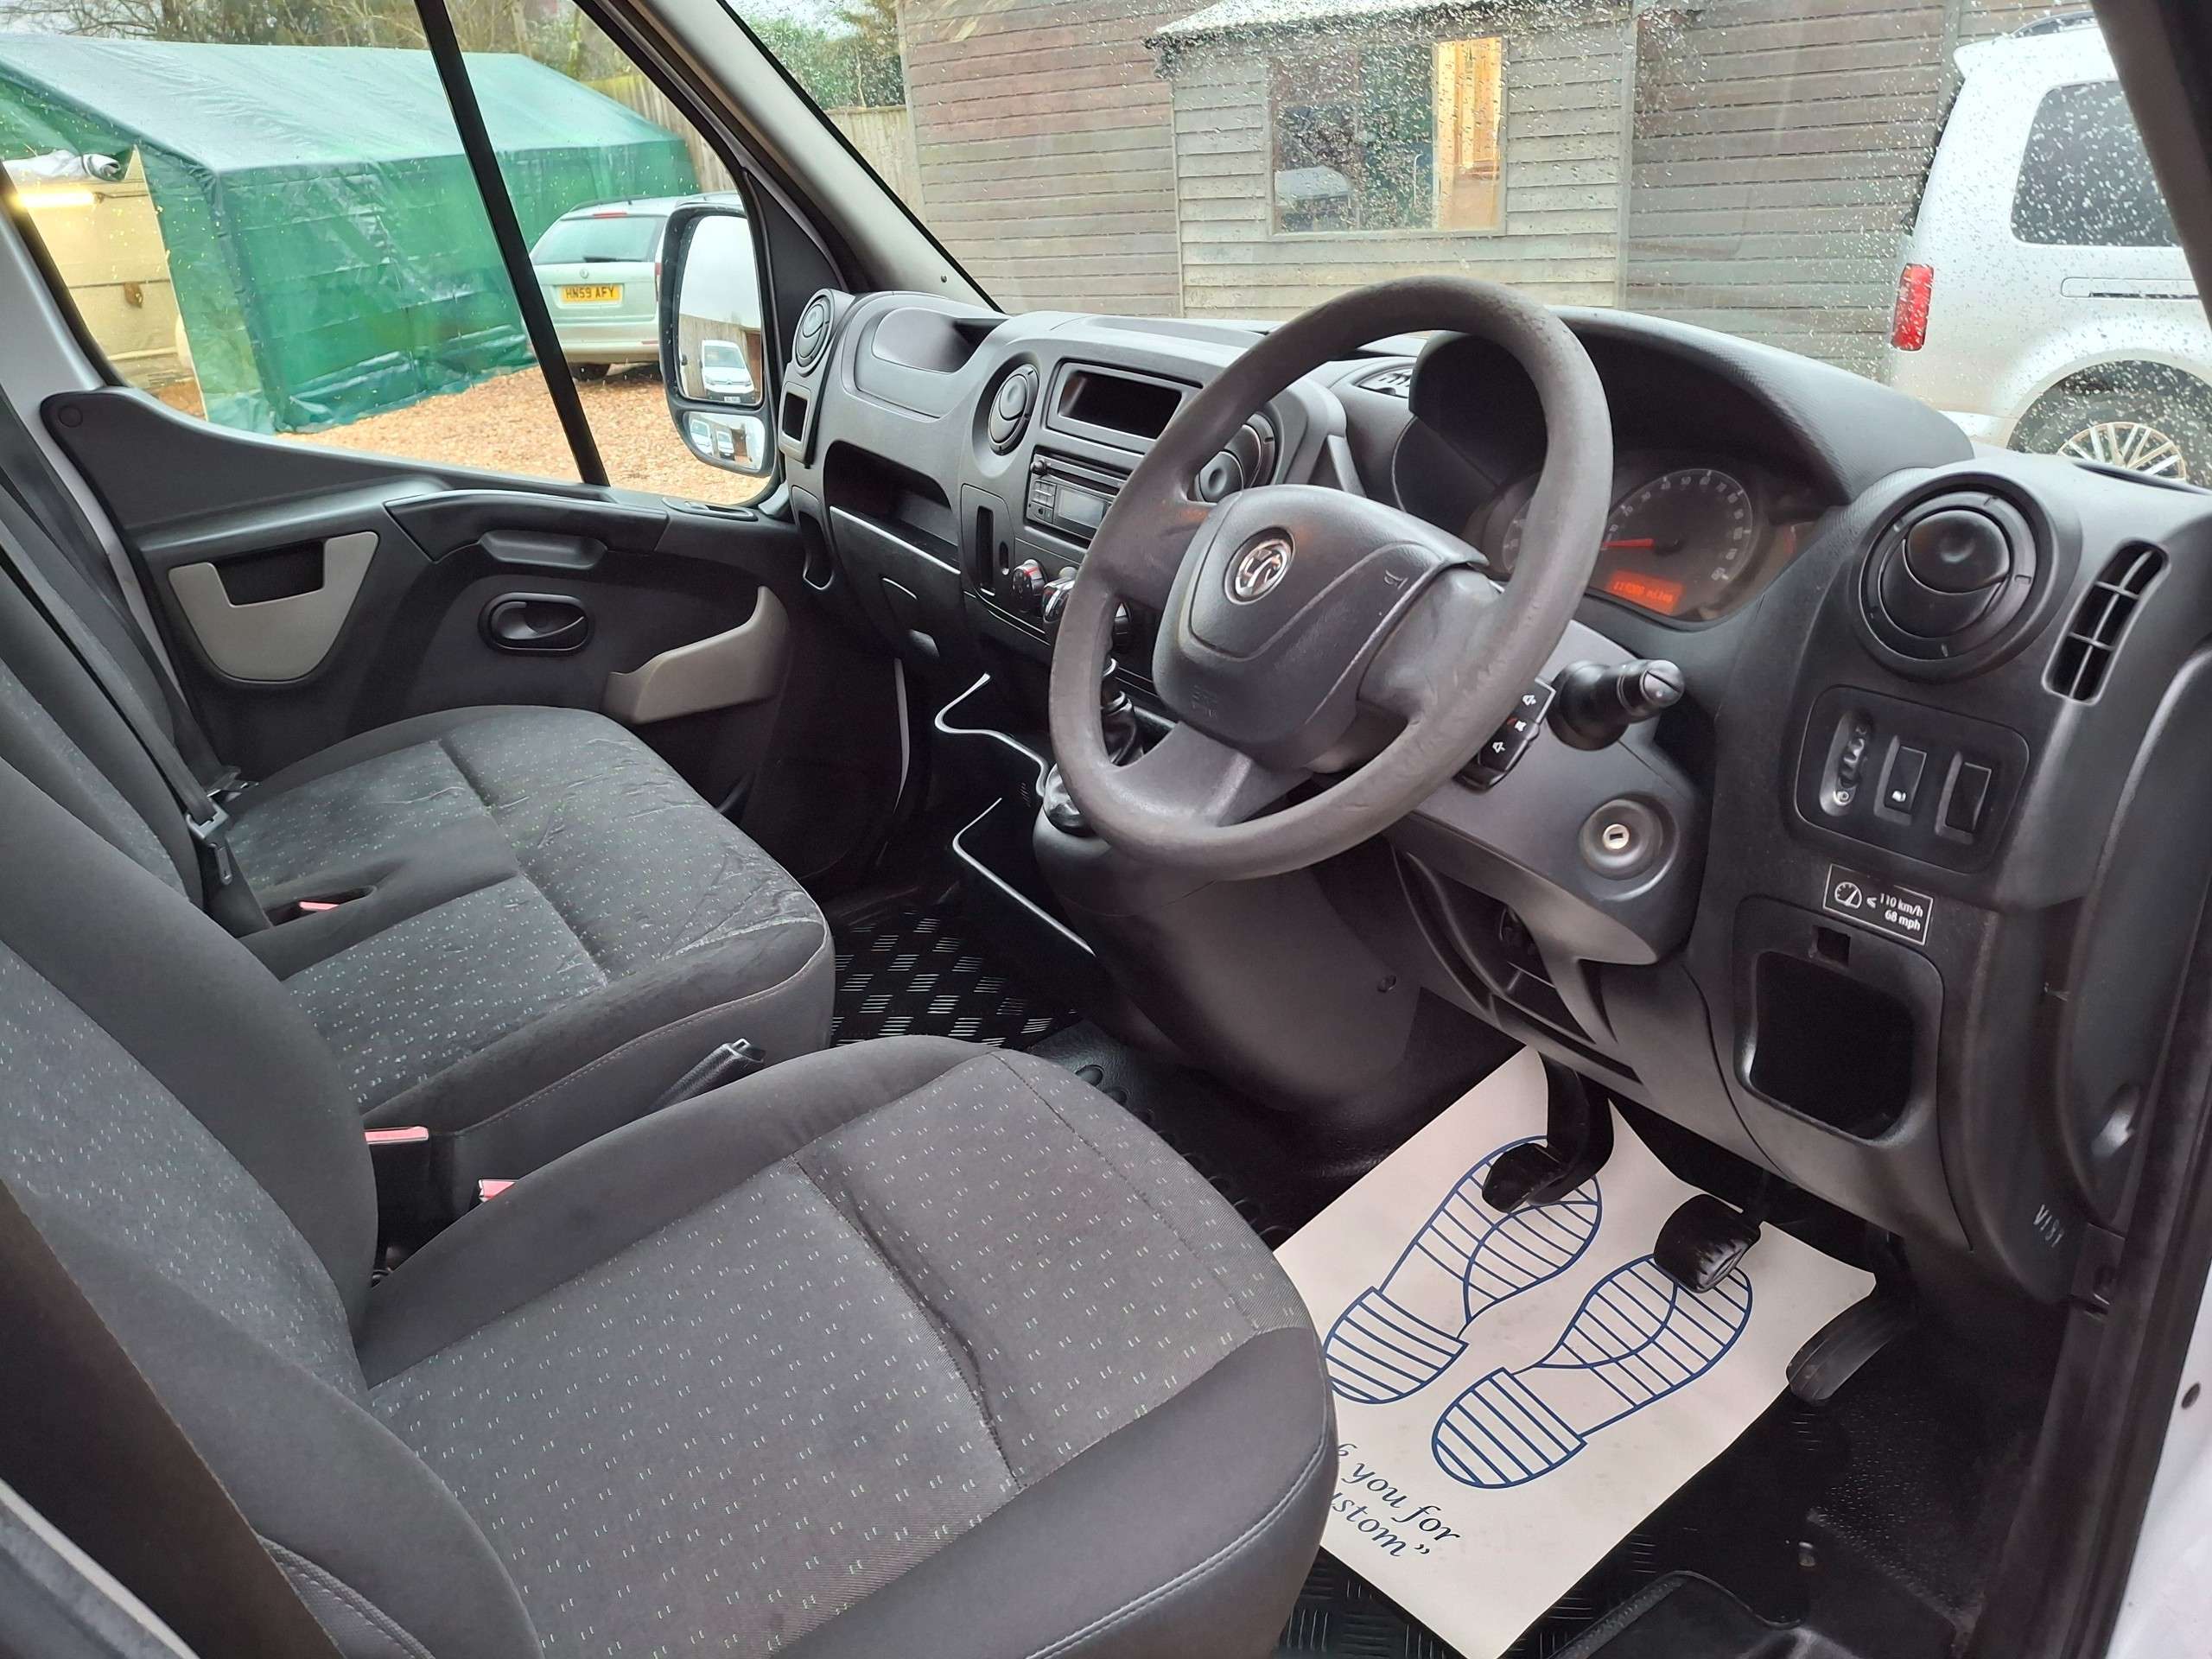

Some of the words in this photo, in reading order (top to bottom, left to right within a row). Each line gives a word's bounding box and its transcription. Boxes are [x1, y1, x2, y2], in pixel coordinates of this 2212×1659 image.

[595, 286, 614, 298] AFY
[1879, 893, 1897, 906] 110
[1897, 898, 1924, 918] km/h
[1884, 909, 1897, 923] 68
[1898, 915, 1921, 931] mph
[1340, 1462, 1408, 1509] you
[1390, 1505, 1461, 1541] for
